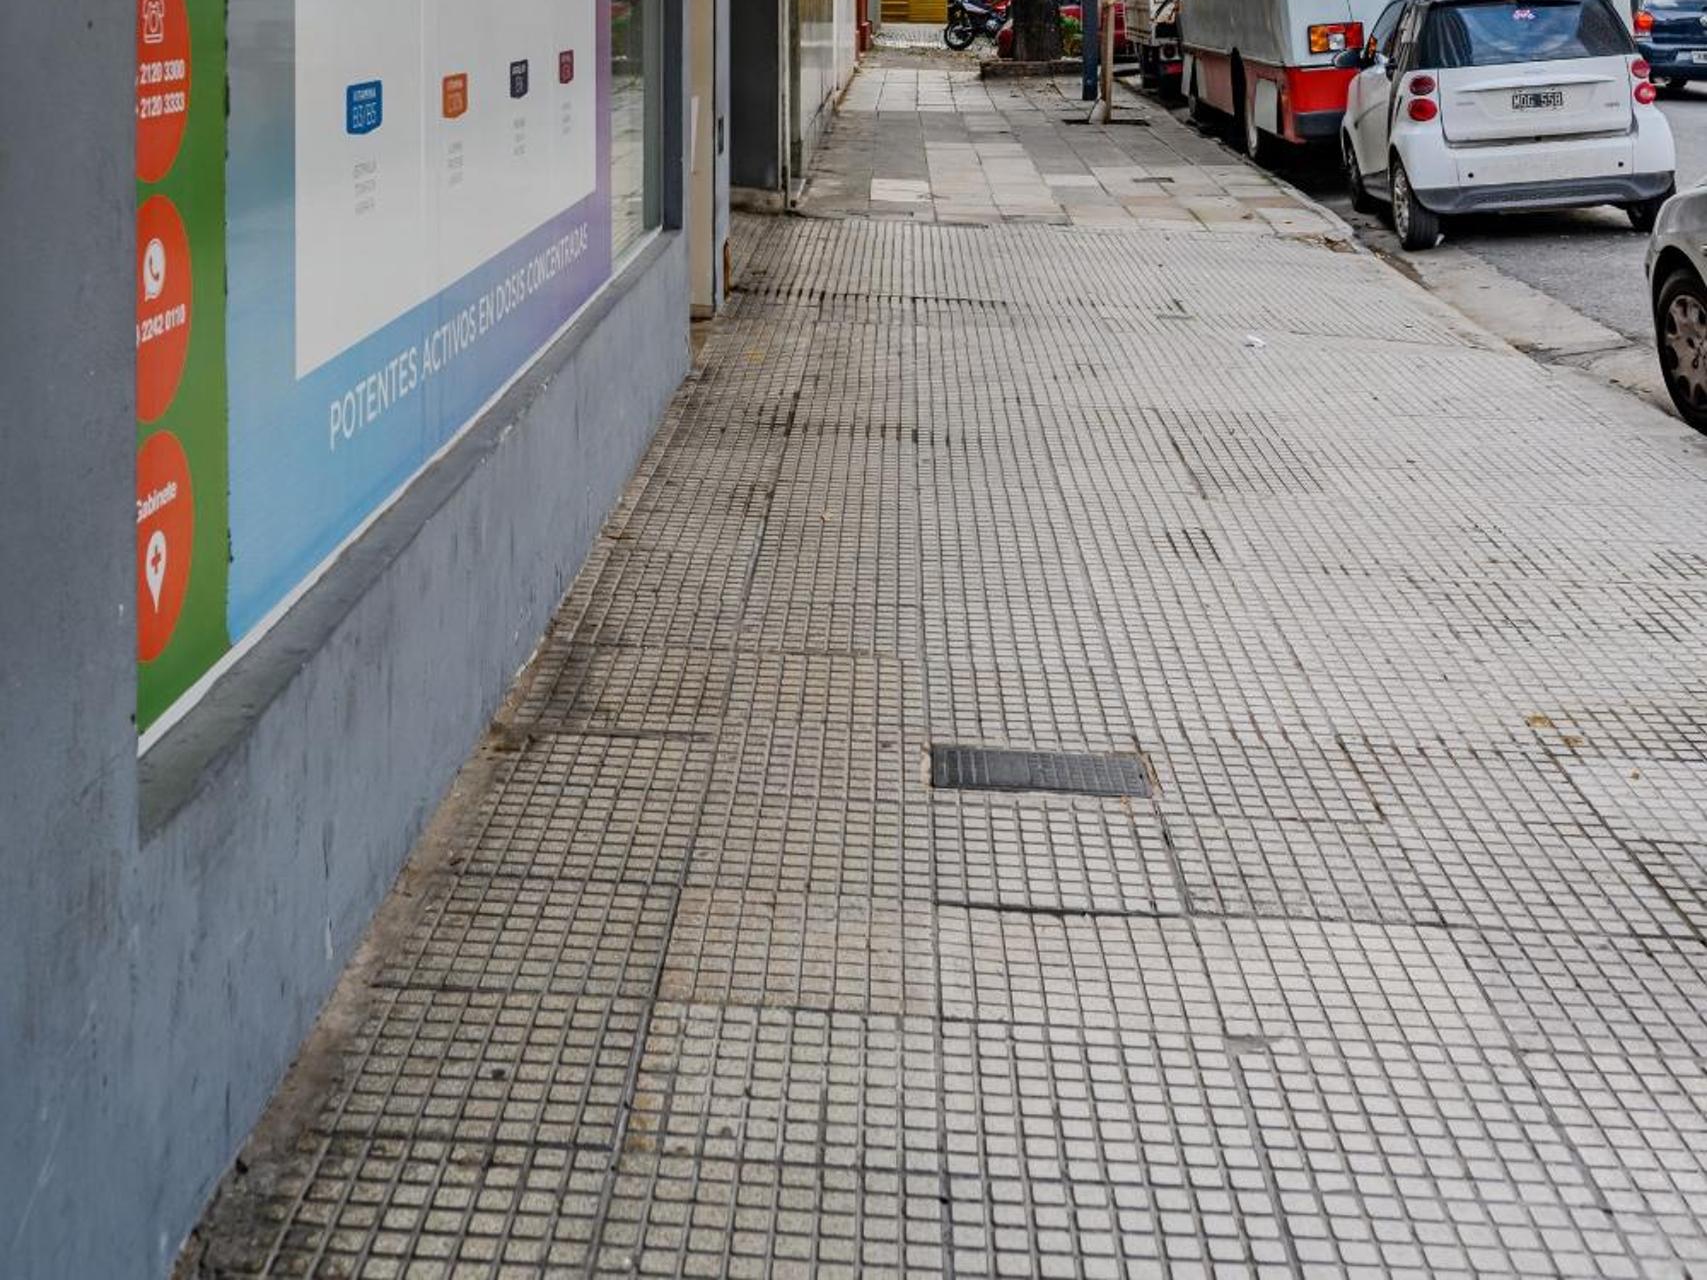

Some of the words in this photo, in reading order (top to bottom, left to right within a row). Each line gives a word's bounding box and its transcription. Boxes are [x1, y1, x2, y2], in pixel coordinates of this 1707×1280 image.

[140, 61, 162, 84] 2120
[140, 94, 162, 118] 2120
[329, 346, 418, 453] POTENTES
[420, 304, 477, 381] ACTIVOS
[478, 291, 495, 336] EN
[496, 268, 525, 321] DOSIS
[525, 222, 589, 295] CONCENTRADAS
